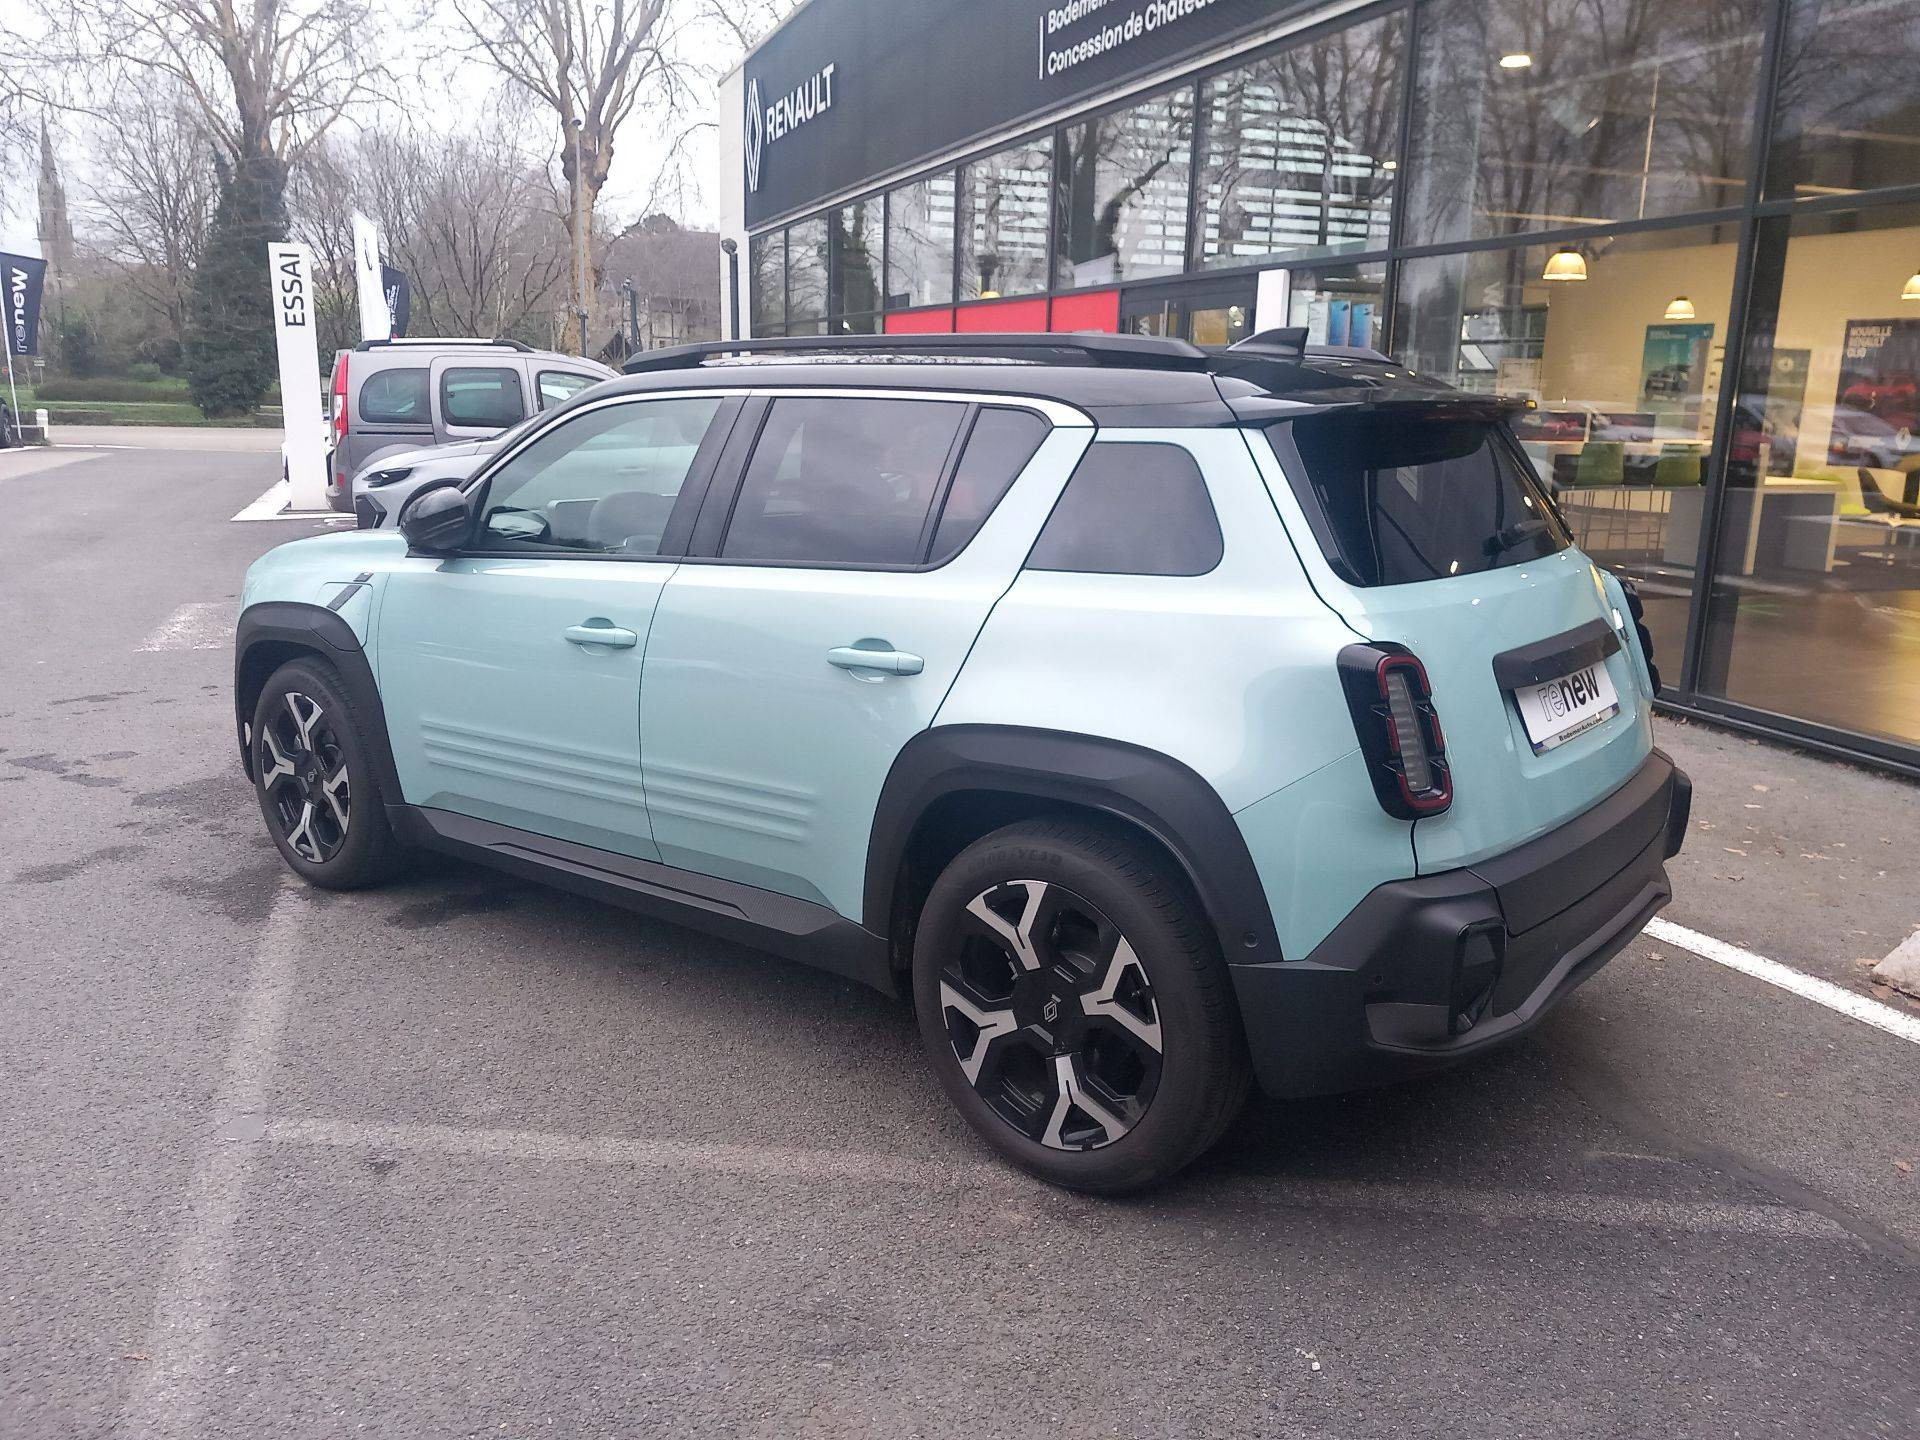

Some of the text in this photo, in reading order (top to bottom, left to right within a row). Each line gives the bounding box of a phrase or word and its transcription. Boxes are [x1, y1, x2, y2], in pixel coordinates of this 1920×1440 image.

[1047, 26, 1123, 75] Concession
[1124, 11, 1143, 41] de
[766, 62, 834, 145] RENAULT
[11, 266, 28, 353] renew
[279, 252, 306, 328] ESSAI
[1537, 667, 1600, 722] renew
